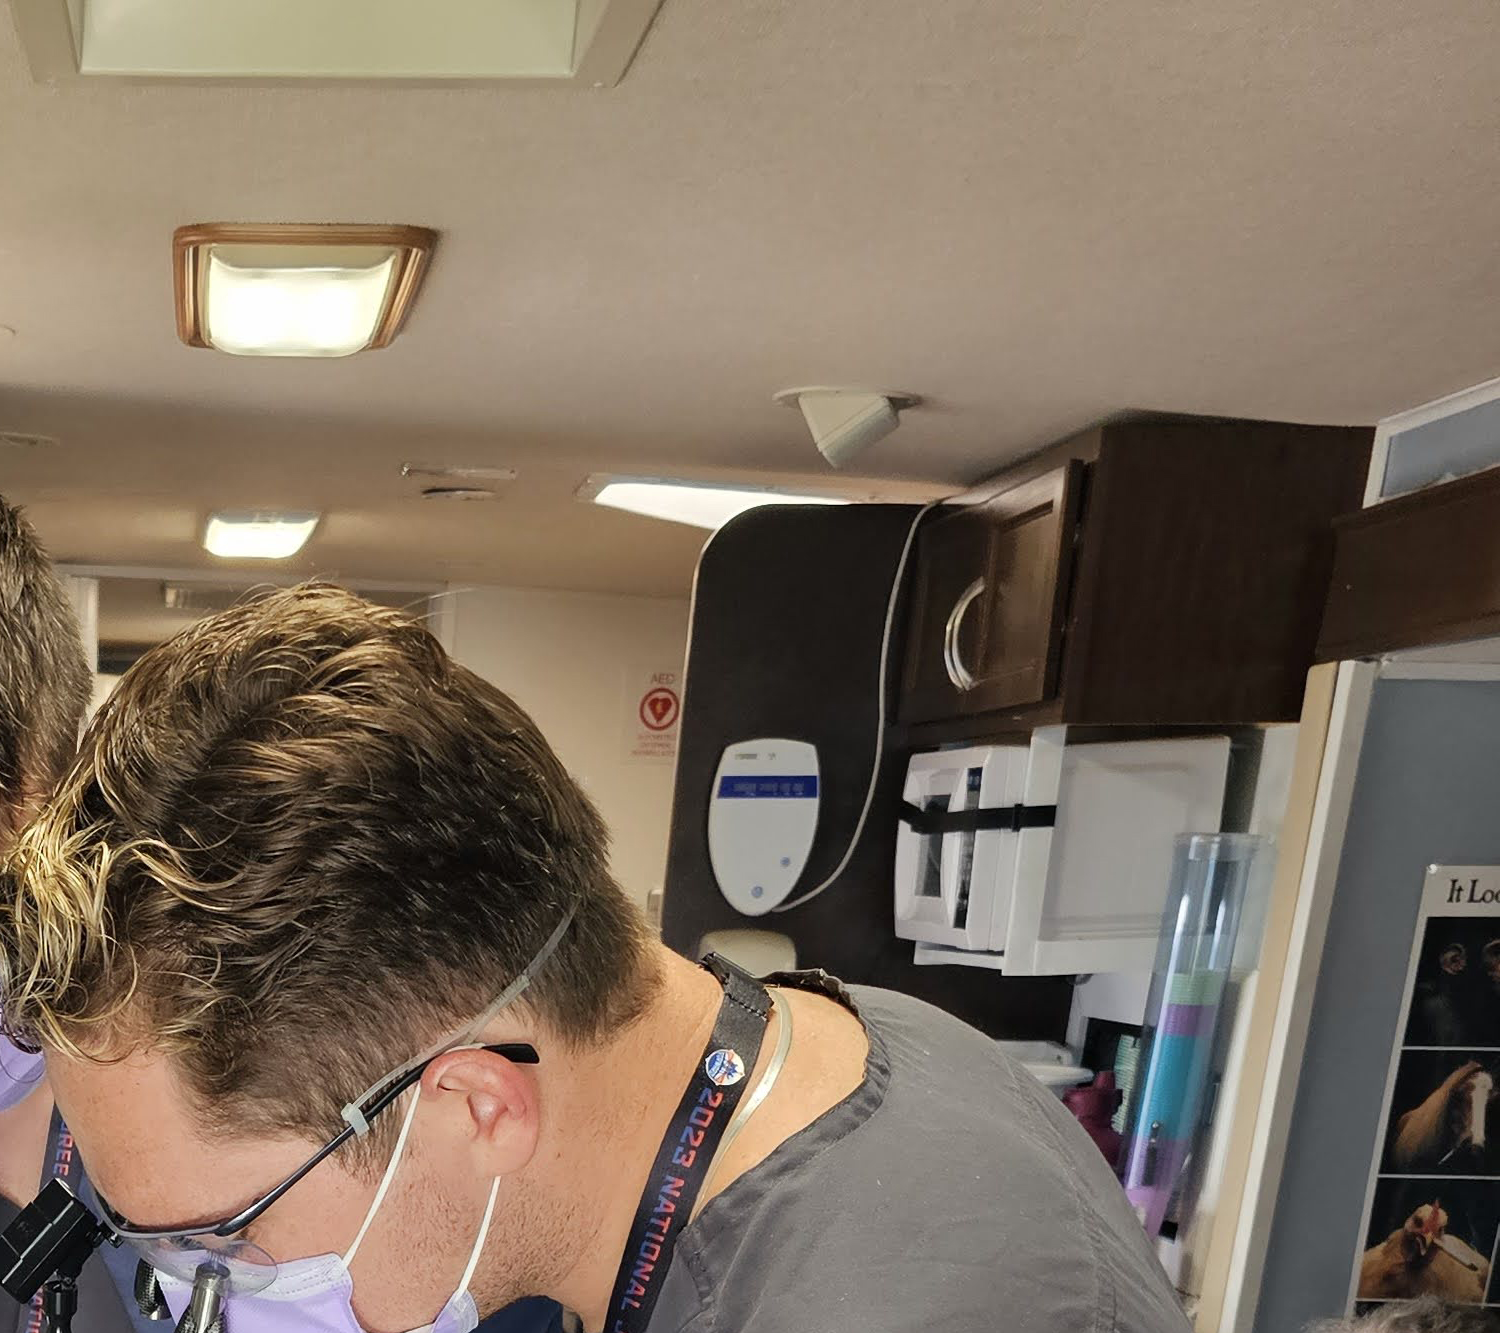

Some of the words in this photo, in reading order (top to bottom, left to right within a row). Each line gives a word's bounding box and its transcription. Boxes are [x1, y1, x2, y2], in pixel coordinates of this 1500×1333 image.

[1446, 878, 1464, 904] It
[670, 1086, 724, 1169] 2023
[620, 1174, 686, 1311] NATIONAL
